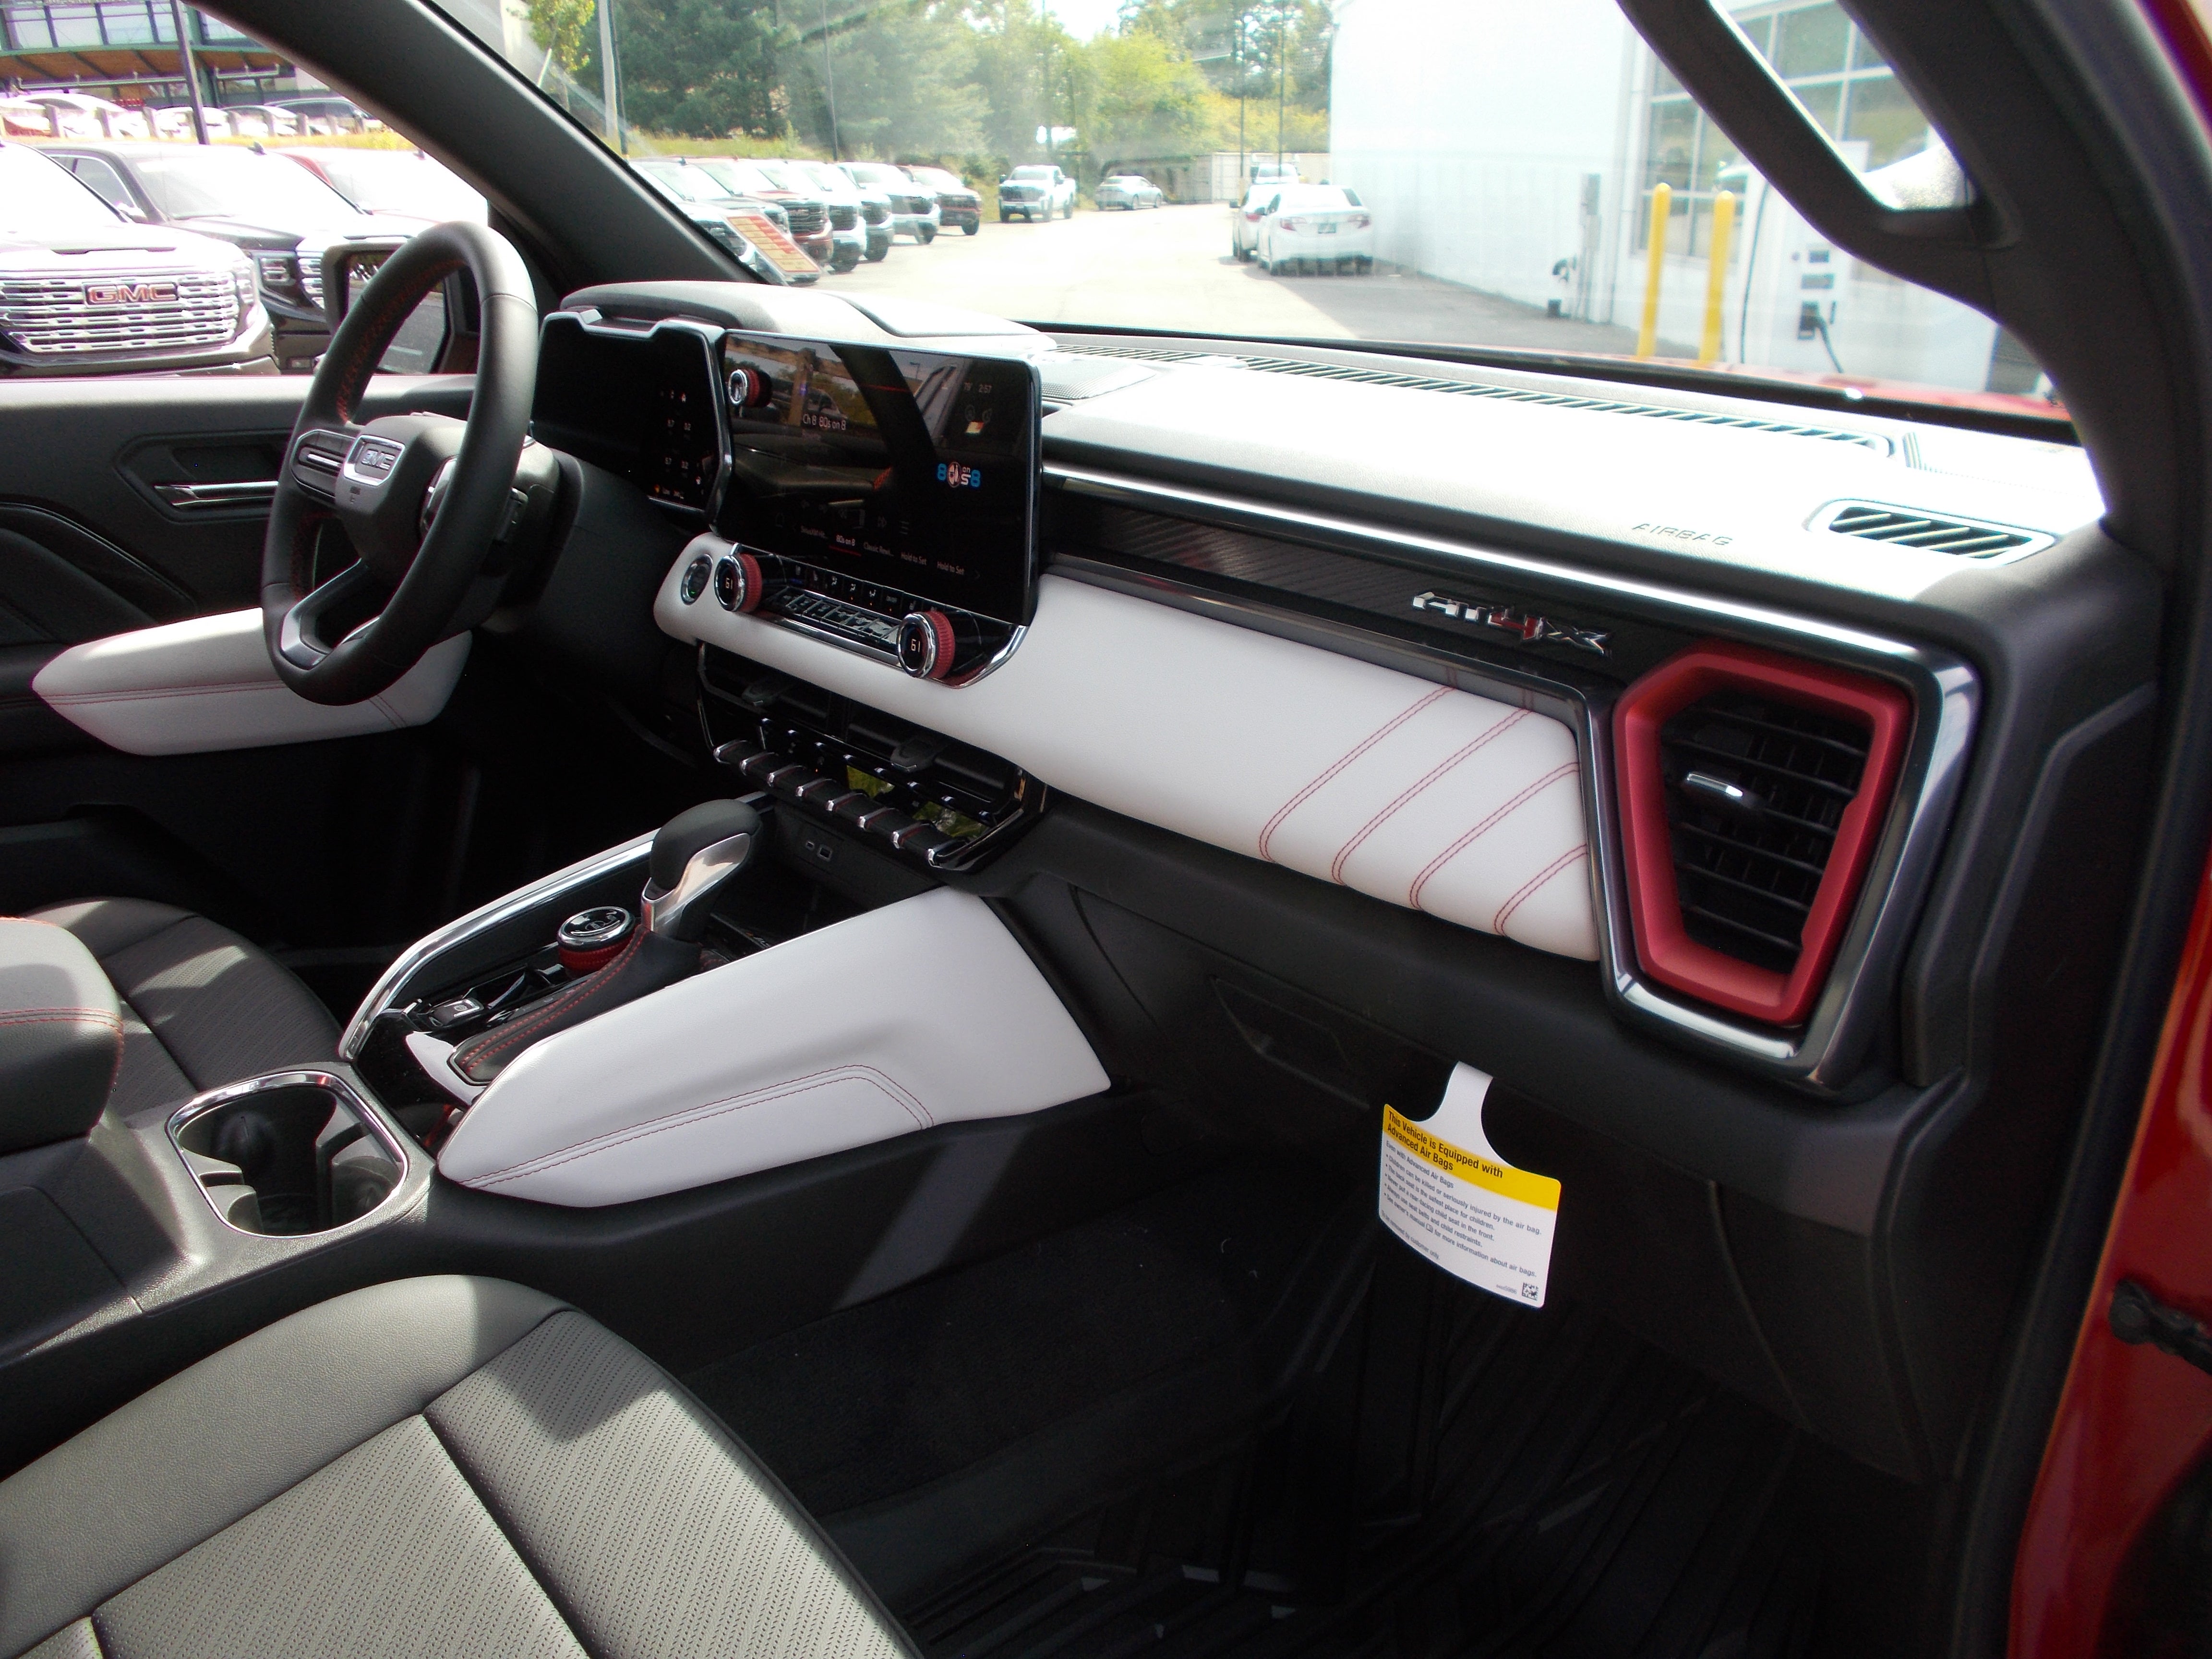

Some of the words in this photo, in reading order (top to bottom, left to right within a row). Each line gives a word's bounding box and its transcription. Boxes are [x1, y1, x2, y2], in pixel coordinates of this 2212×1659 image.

[88, 284, 177, 304] GMC
[803, 413, 811, 425] Ch
[811, 414, 817, 426] 8
[819, 416, 831, 428] 80s
[831, 421, 840, 430] on
[841, 419, 846, 431] 8
[851, 538, 855, 547] 8
[1632, 523, 1733, 546] AIRBAG
[901, 552, 913, 562] Hold
[918, 555, 927, 565] Set
[937, 560, 949, 572] Hold
[955, 565, 965, 575] Set
[725, 577, 733, 590] 61
[911, 638, 920, 653] 61
[1388, 1123, 1418, 1152] Advanced
[1420, 1146, 1431, 1158] Air
[1433, 1153, 1454, 1170] Bags
[1389, 1110, 1401, 1127] This
[1403, 1121, 1427, 1144] Vehicle
[1430, 1138, 1436, 1149] is
[1439, 1143, 1479, 1169] Equipped
[1482, 1163, 1503, 1178] with
[1386, 1140, 1396, 1153] Even
[1396, 1150, 1406, 1160] with
[1407, 1156, 1430, 1176] Advanced
[1440, 1176, 1454, 1189] Bags
[1389, 1155, 1406, 1171] Children
[1414, 1175, 1421, 1183] be
[1421, 1178, 1435, 1191] killed
[1443, 1192, 1468, 1209] seriously
[1470, 1203, 1491, 1218] injured
[1493, 1213, 1501, 1223] by
[1503, 1216, 1514, 1226] the
[1527, 1224, 1542, 1235] bag.
[1406, 1179, 1414, 1190] seat
[1420, 1189, 1428, 1198] the
[1429, 1195, 1444, 1207] safest
[1444, 1204, 1459, 1215] place
[1460, 1210, 1468, 1219] for
[1469, 1215, 1494, 1230] children.
[1419, 1208, 1430, 1220] belts
[1430, 1217, 1440, 1226] and
[1441, 1223, 1453, 1234] child
[1454, 1229, 1483, 1248] restraints.
[1435, 1209, 1448, 1220] child
[1448, 1216, 1460, 1226] seat
[1461, 1221, 1467, 1229] in
[1467, 1225, 1477, 1234] the
[1478, 1229, 1495, 1241] front.
[1442, 1234, 1455, 1246] more
[1456, 1241, 1489, 1261] information
[1490, 1257, 1508, 1271] about
[1518, 1266, 1537, 1277] bags.
